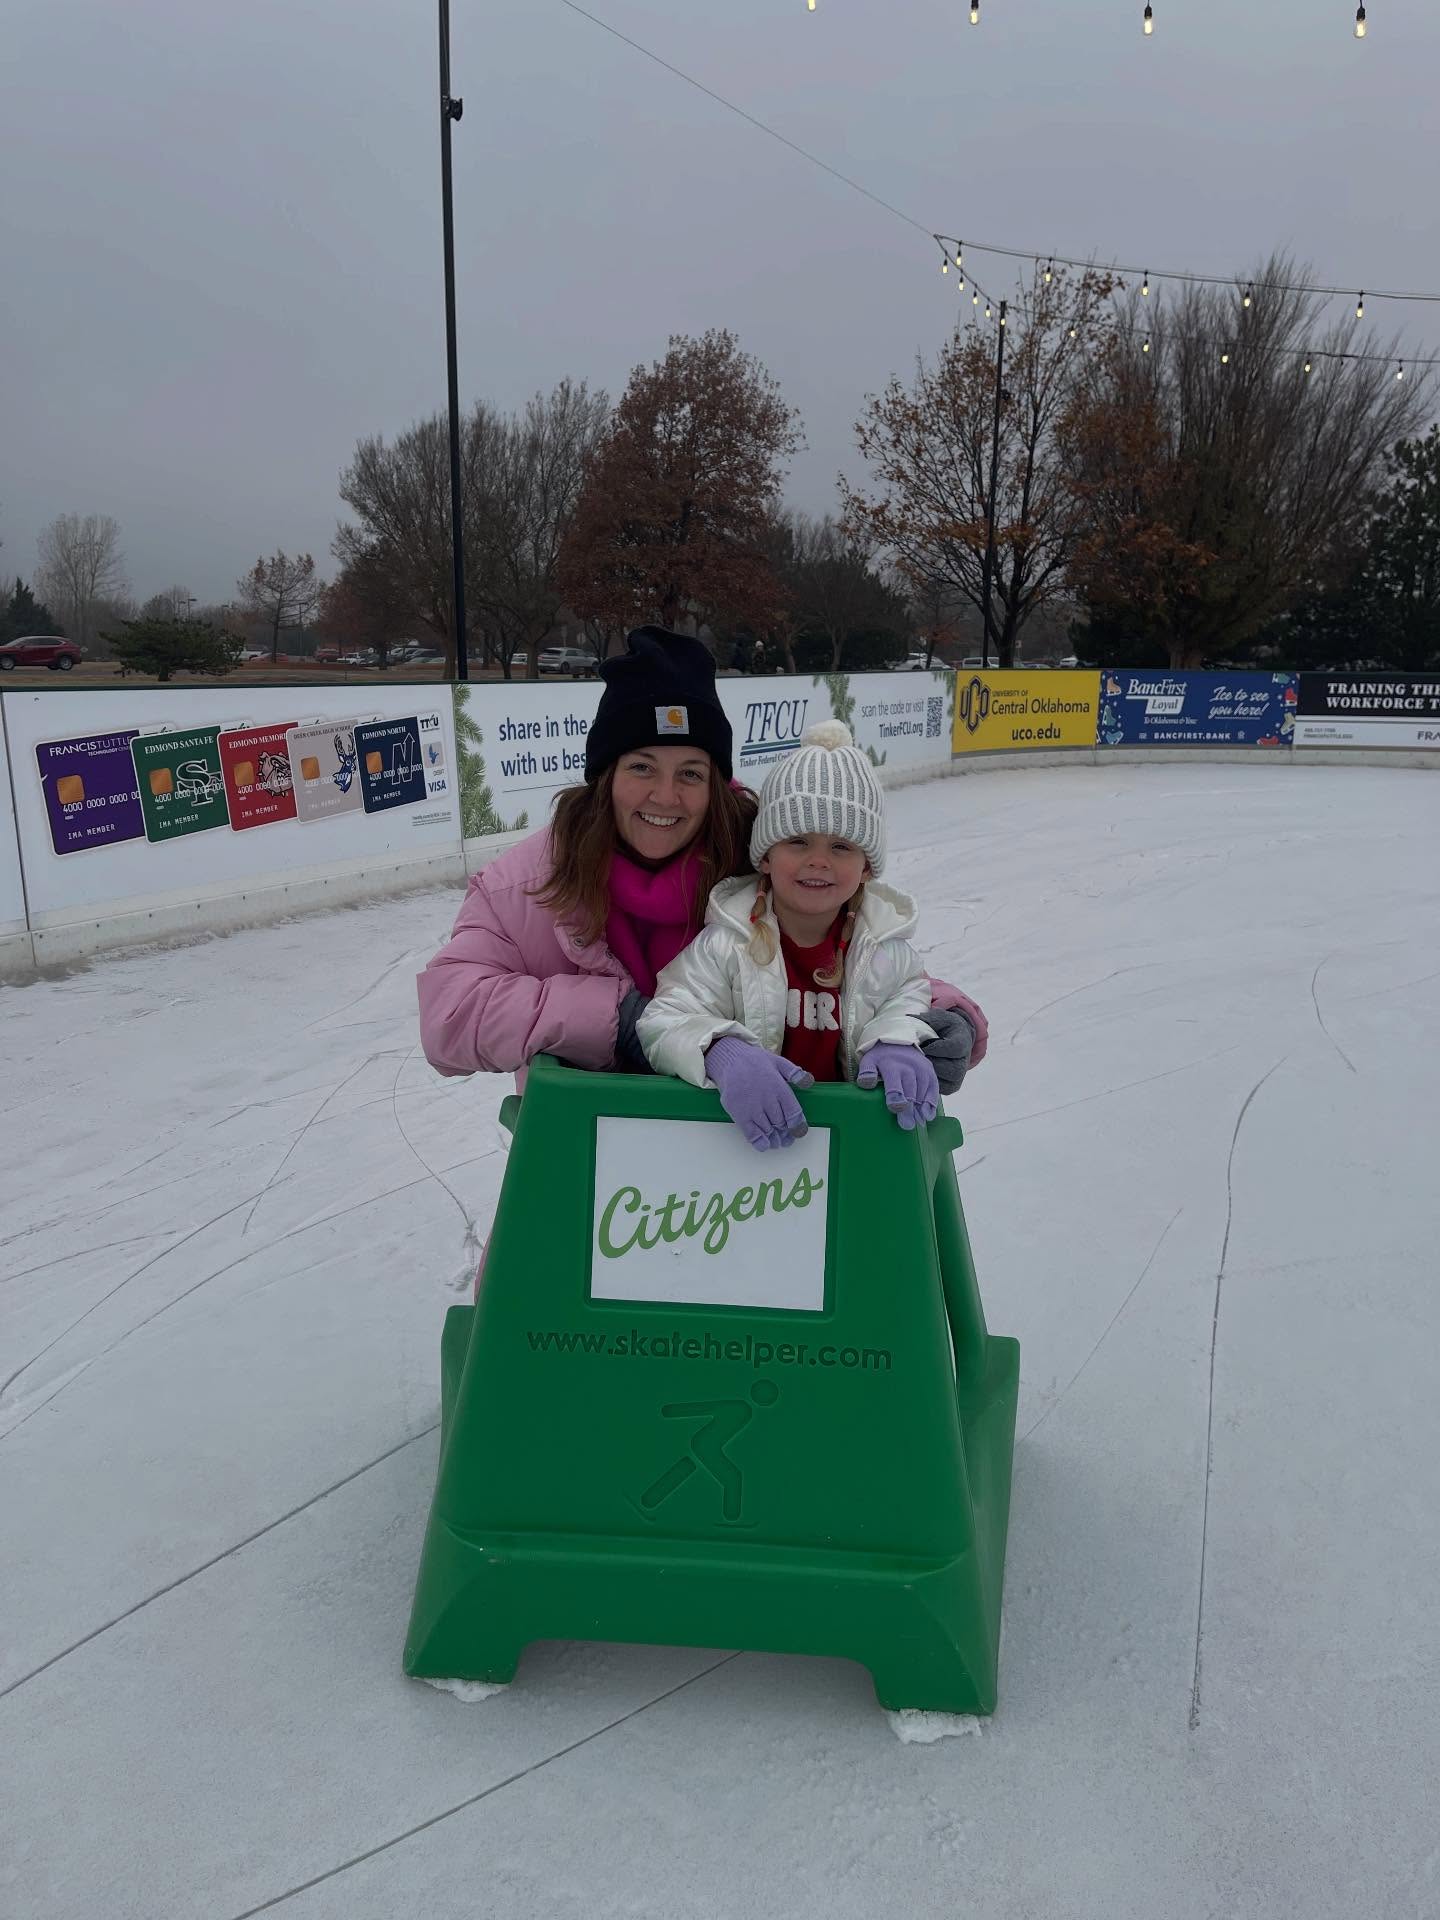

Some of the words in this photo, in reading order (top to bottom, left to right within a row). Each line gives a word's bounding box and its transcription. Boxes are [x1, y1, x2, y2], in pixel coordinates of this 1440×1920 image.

[1128, 679, 1187, 695] BancFirst
[1235, 689, 1247, 701] to
[1250, 691, 1269, 701] see
[1328, 683, 1406, 695] TRAINING
[861, 705, 877, 718] scan
[878, 700, 888, 716] the
[890, 700, 904, 715] code
[913, 701, 924, 713] visit
[991, 698, 1028, 715] Central
[1031, 698, 1090, 714] Oklahoma
[1151, 699, 1179, 712] Loyal
[1326, 697, 1424, 709] WORKFORCE
[745, 699, 808, 743] TFCU
[1208, 706, 1232, 719] you
[362, 730, 387, 740] EDMOND
[387, 726, 406, 735] NORTH
[499, 717, 541, 741] share
[545, 715, 559, 738] in
[564, 714, 588, 736] the
[879, 721, 924, 738] TinkerFCU.org
[1011, 723, 1061, 741] uco.edu
[1154, 732, 1231, 740] BANCFIRST.BANK
[145, 742, 179, 755] EDMOND
[179, 736, 204, 750] SANTA
[204, 735, 214, 745] FE
[228, 737, 258, 749] EDMOND
[259, 732, 287, 744] MEMORI
[501, 750, 537, 776] with
[542, 755, 558, 772] us
[563, 748, 586, 770] bes
[758, 754, 778, 765] Federal
[428, 780, 447, 793] VISA
[63, 801, 83, 813] 4000
[86, 797, 106, 809] 0000
[109, 793, 128, 805] 0000
[131, 790, 141, 800] 00
[255, 804, 278, 815] MEMBER
[174, 813, 199, 825] MEMBER
[68, 831, 83, 840] IMA
[86, 823, 115, 836] MEMBER
[599, 1167, 824, 1259] Citizens
[526, 1329, 893, 1370] www.skatehelper.com
